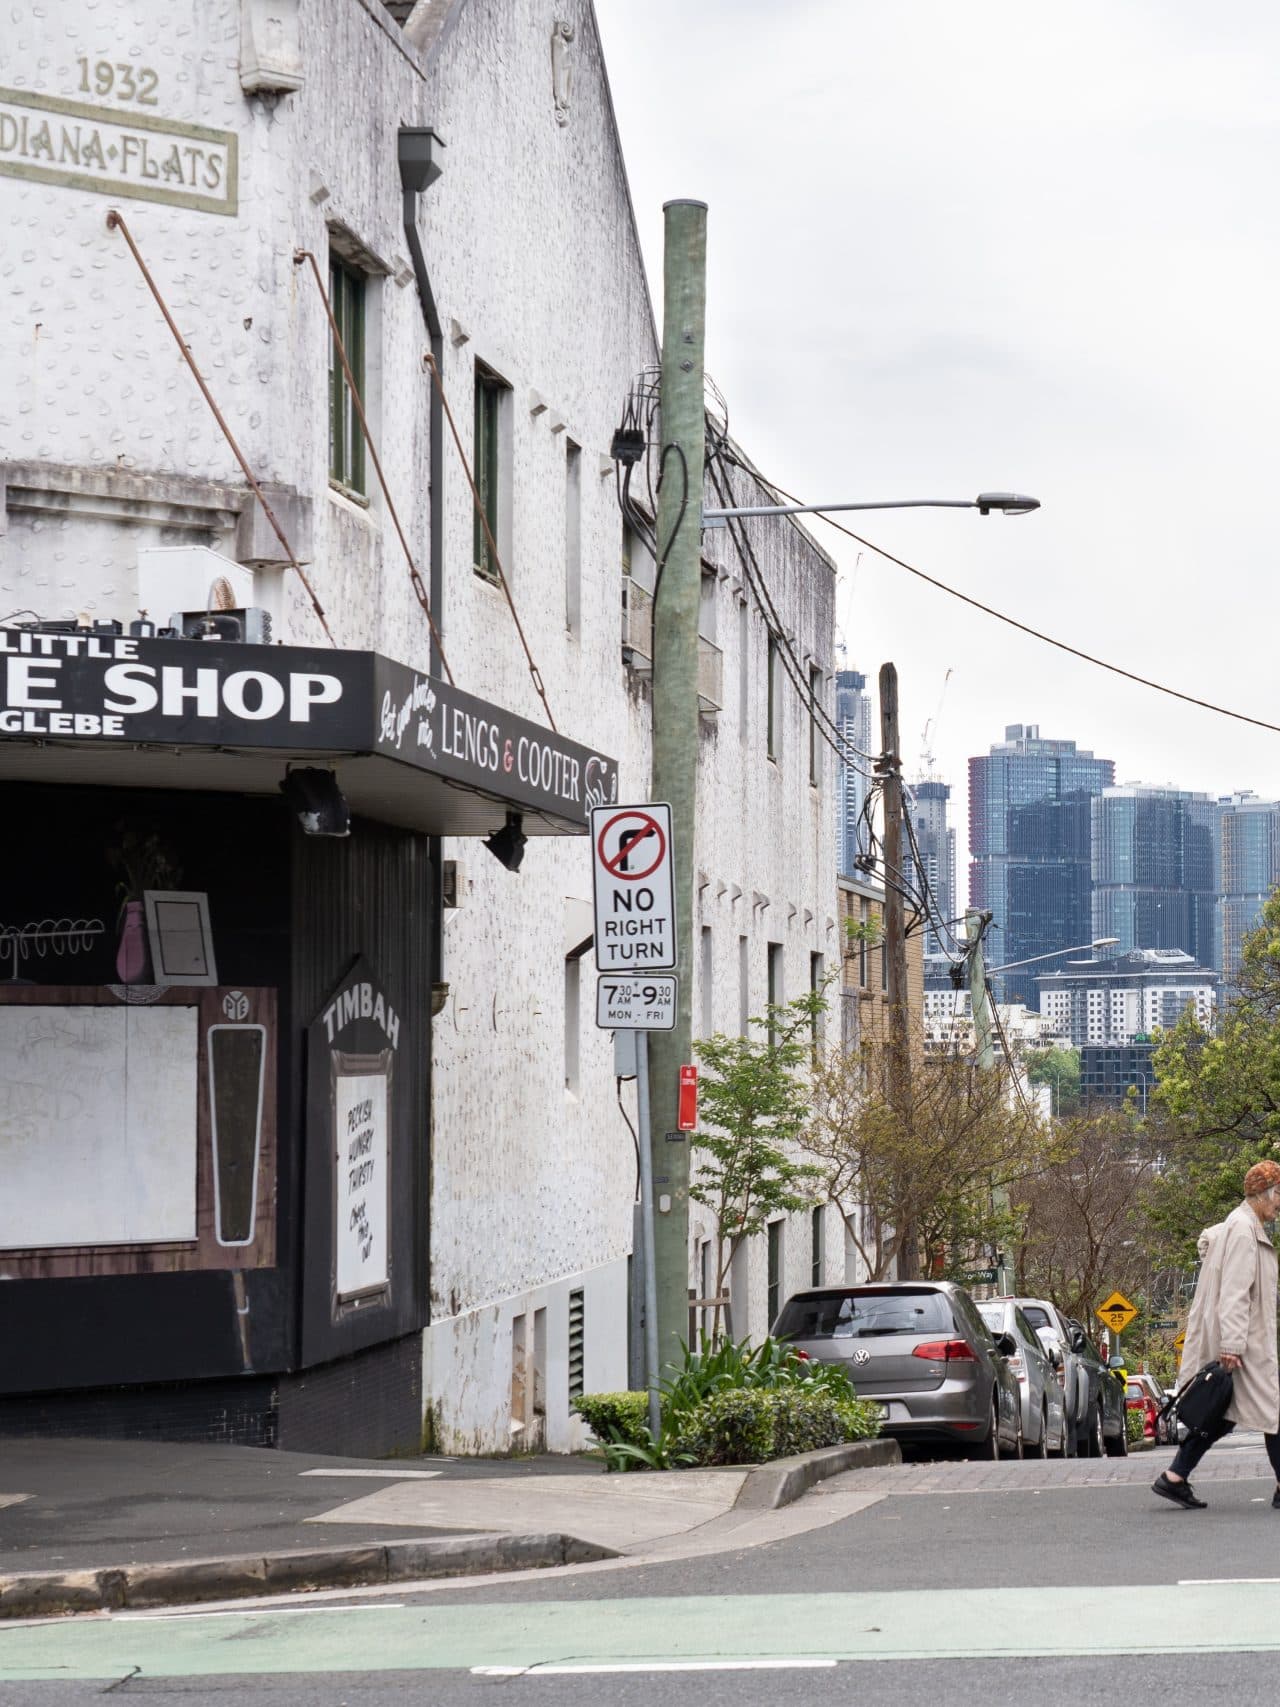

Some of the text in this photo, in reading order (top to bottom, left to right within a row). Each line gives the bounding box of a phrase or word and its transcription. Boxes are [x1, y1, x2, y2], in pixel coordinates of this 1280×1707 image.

[77, 56, 159, 106] 1932
[0, 112, 223, 190] DIANA FLATS
[0, 631, 140, 660] LITTLE
[103, 663, 343, 722] SHOP
[0, 710, 125, 736] GLEBE
[441, 703, 500, 772] LENGS
[503, 738, 514, 773] &
[518, 736, 580, 802] COOTER
[613, 888, 655, 913] NO
[605, 918, 666, 937] RIGHT
[607, 942, 664, 960] TURN
[323, 982, 401, 1051] TIMBAH
[608, 1011, 632, 1020] MON
[646, 1011, 664, 1020] FRI
[1110, 1313, 1125, 1323] 25
